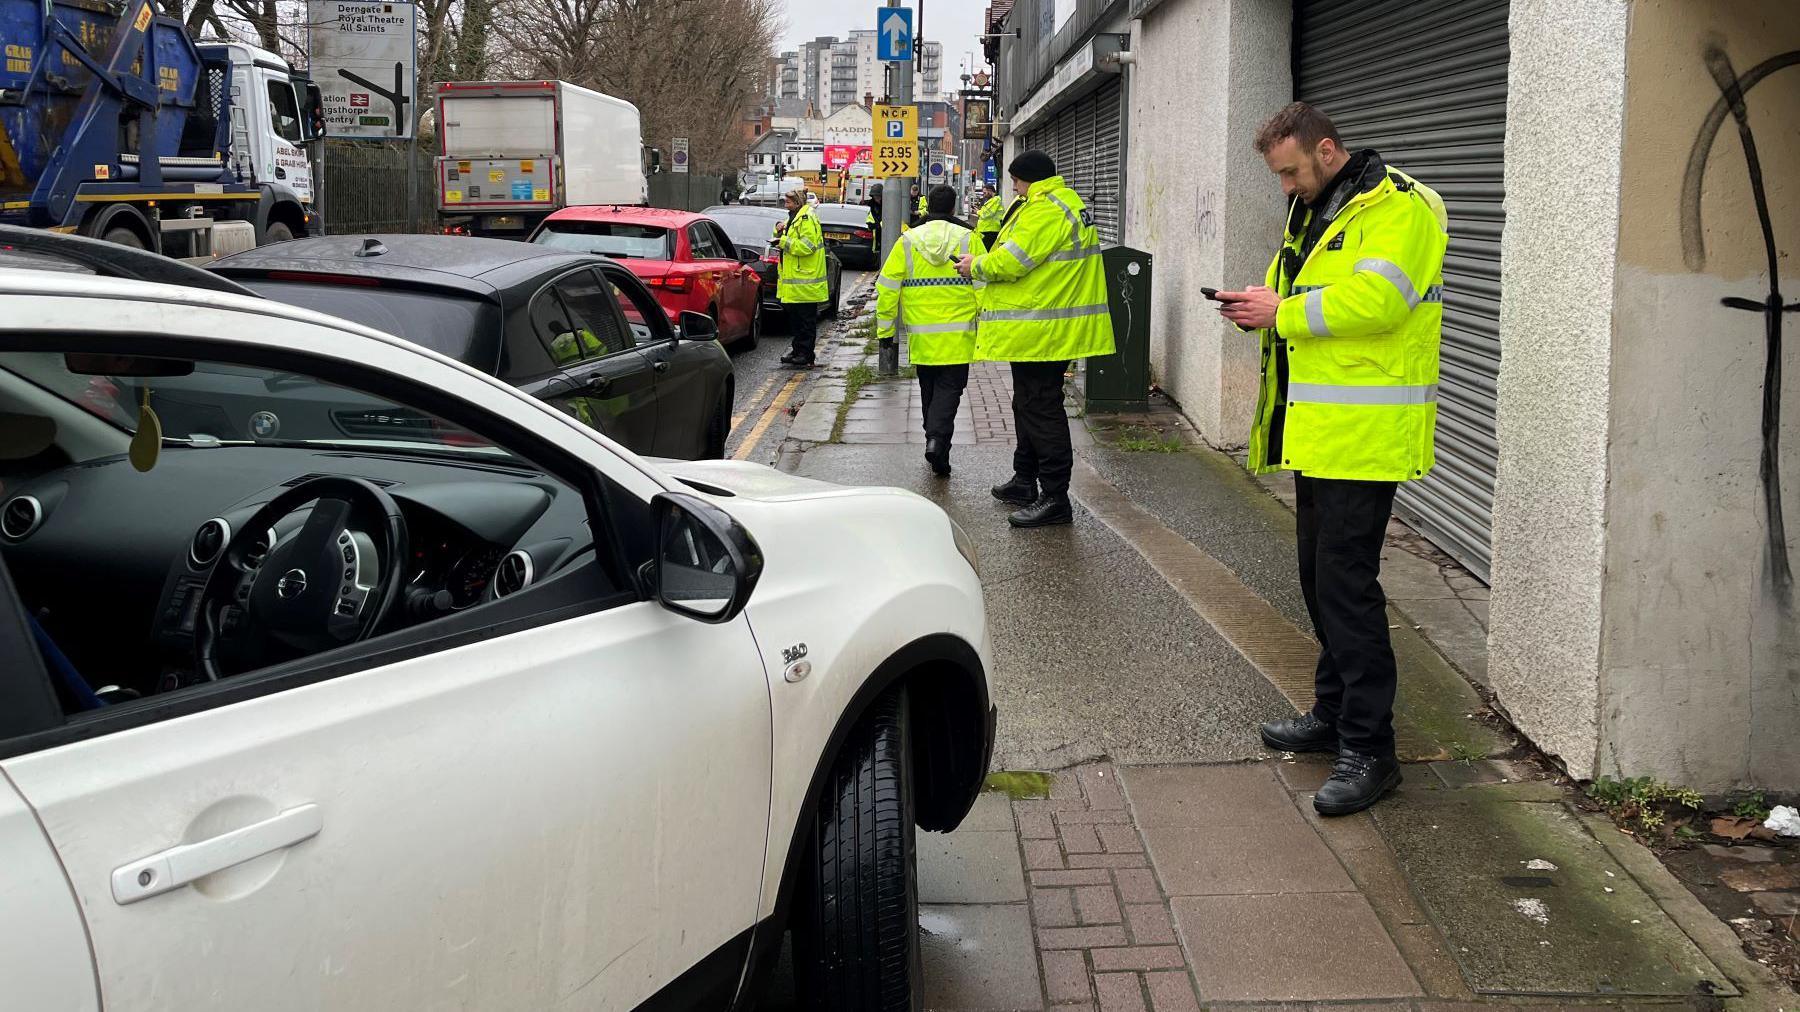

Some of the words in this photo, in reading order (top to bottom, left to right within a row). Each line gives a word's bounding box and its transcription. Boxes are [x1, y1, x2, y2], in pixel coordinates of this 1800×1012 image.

[338, 5, 381, 14] Derngate
[338, 15, 365, 24] Royal
[368, 15, 405, 24] Theatre
[340, 24, 352, 32] All
[356, 24, 385, 32] Saints
[321, 95, 346, 103] ation
[322, 106, 369, 115] ngsthorpe
[324, 116, 354, 124] ventry
[276, 147, 291, 156] ABEL
[879, 146, 912, 158] £3.95
